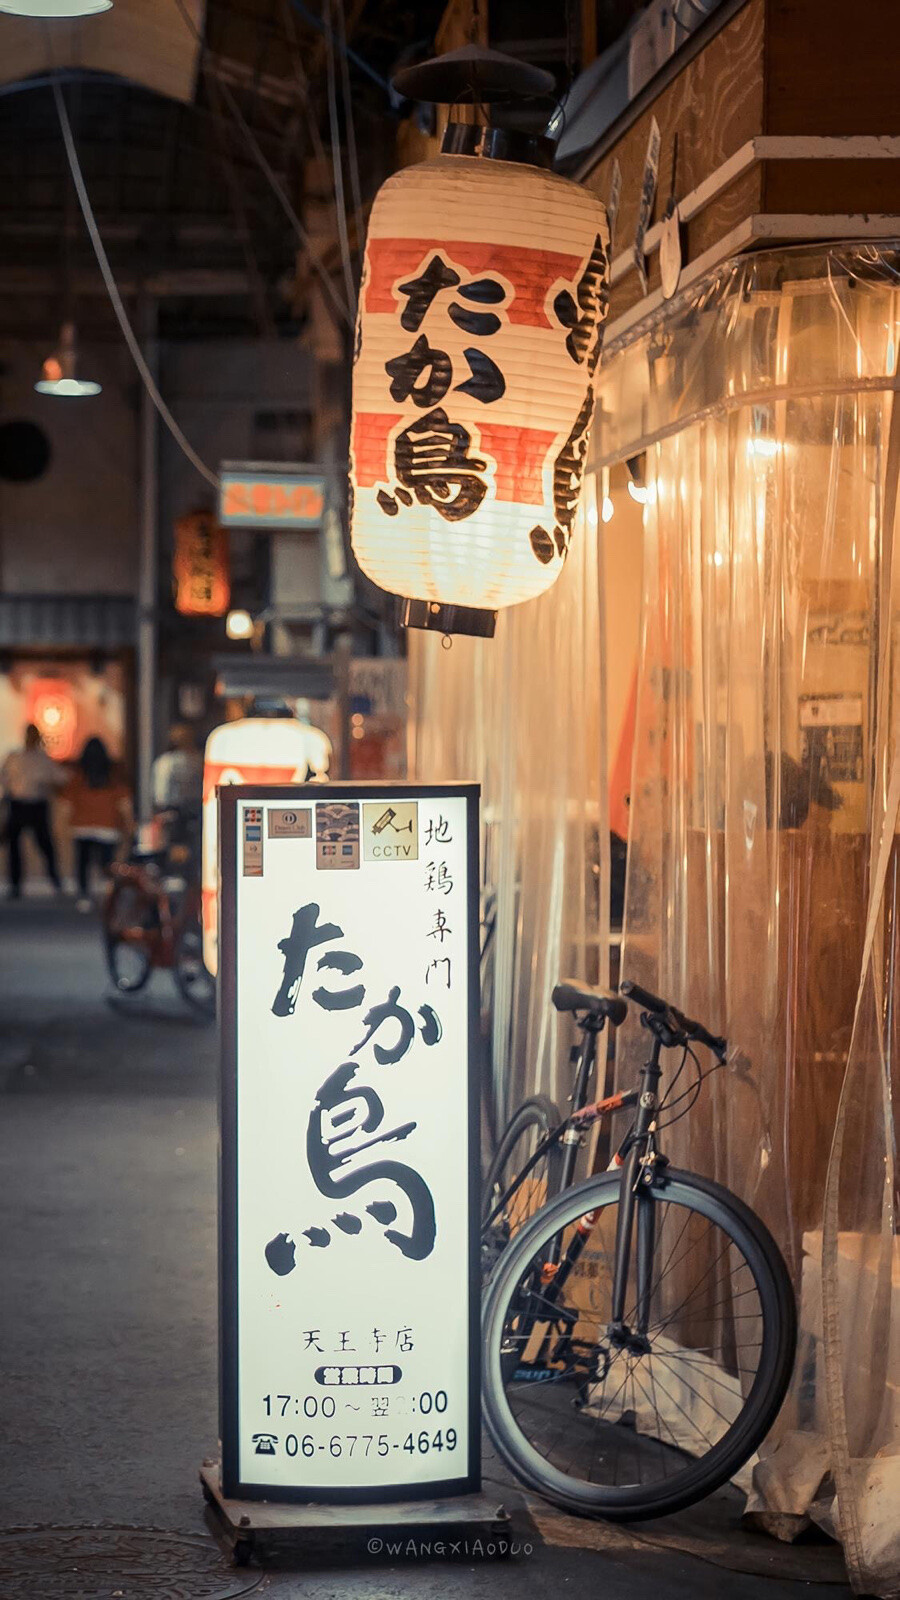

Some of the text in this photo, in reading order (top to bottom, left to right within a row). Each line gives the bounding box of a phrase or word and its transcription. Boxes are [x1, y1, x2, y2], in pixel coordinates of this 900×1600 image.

[376, 254, 508, 522] たか鳥
[372, 845, 411, 857] CCTV
[424, 815, 454, 989] 地鶏専門
[265, 902, 443, 1276] たか鳥
[285, 1427, 457, 1457] 06-6775-4649
